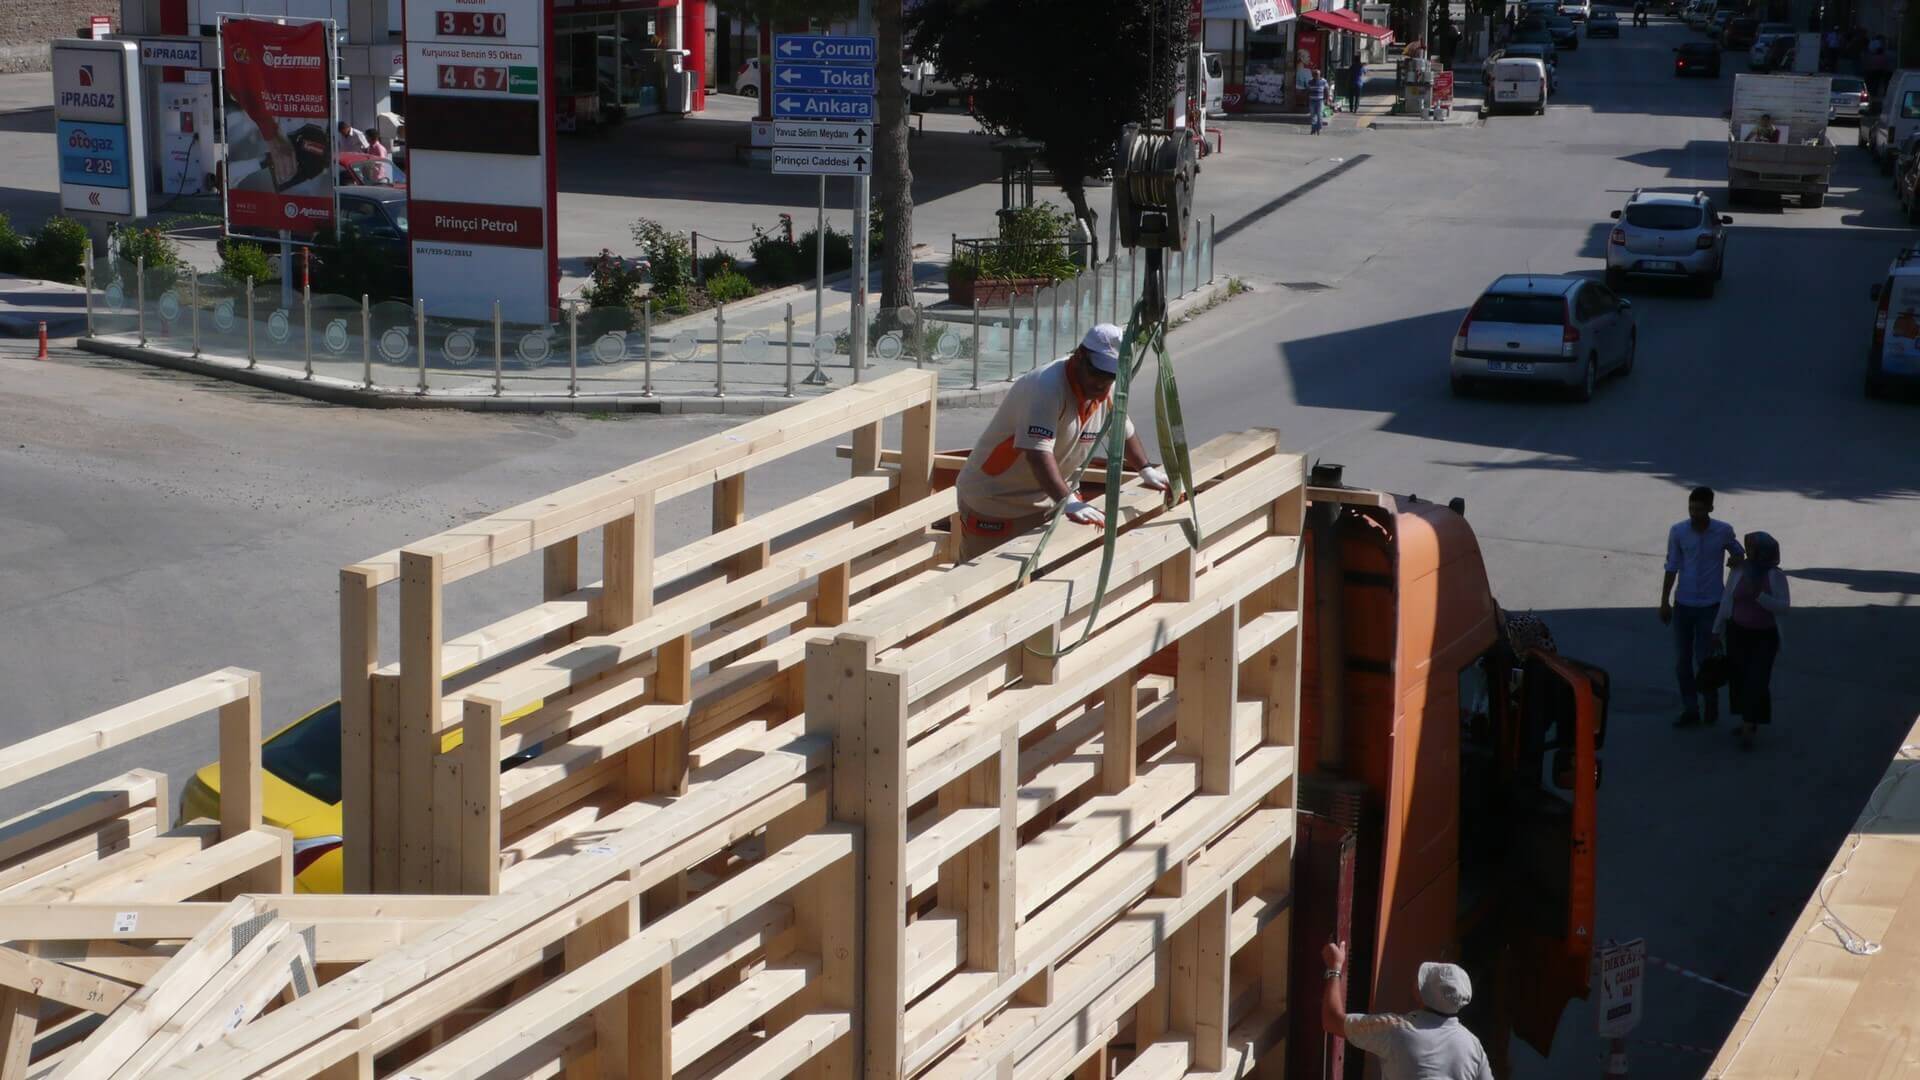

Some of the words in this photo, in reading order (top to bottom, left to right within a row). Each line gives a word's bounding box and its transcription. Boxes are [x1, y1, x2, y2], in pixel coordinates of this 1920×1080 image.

[422, 47, 460, 59] Kurşunsuz
[461, 49, 487, 59] Benzin
[488, 50, 498, 60] 95
[499, 51, 522, 60] Oktan
[812, 40, 871, 58] Çorum
[820, 69, 870, 86] Tokat
[804, 97, 869, 114] Ankara
[68, 131, 114, 153] otogaz
[775, 127, 797, 137] Yavuz
[798, 128, 818, 138] Selim
[819, 129, 849, 140] Meydanı
[775, 155, 809, 167] Pirinçci
[811, 156, 850, 168] Caddesi
[434, 215, 478, 232] Pirinçci
[480, 218, 518, 233] Petrol
